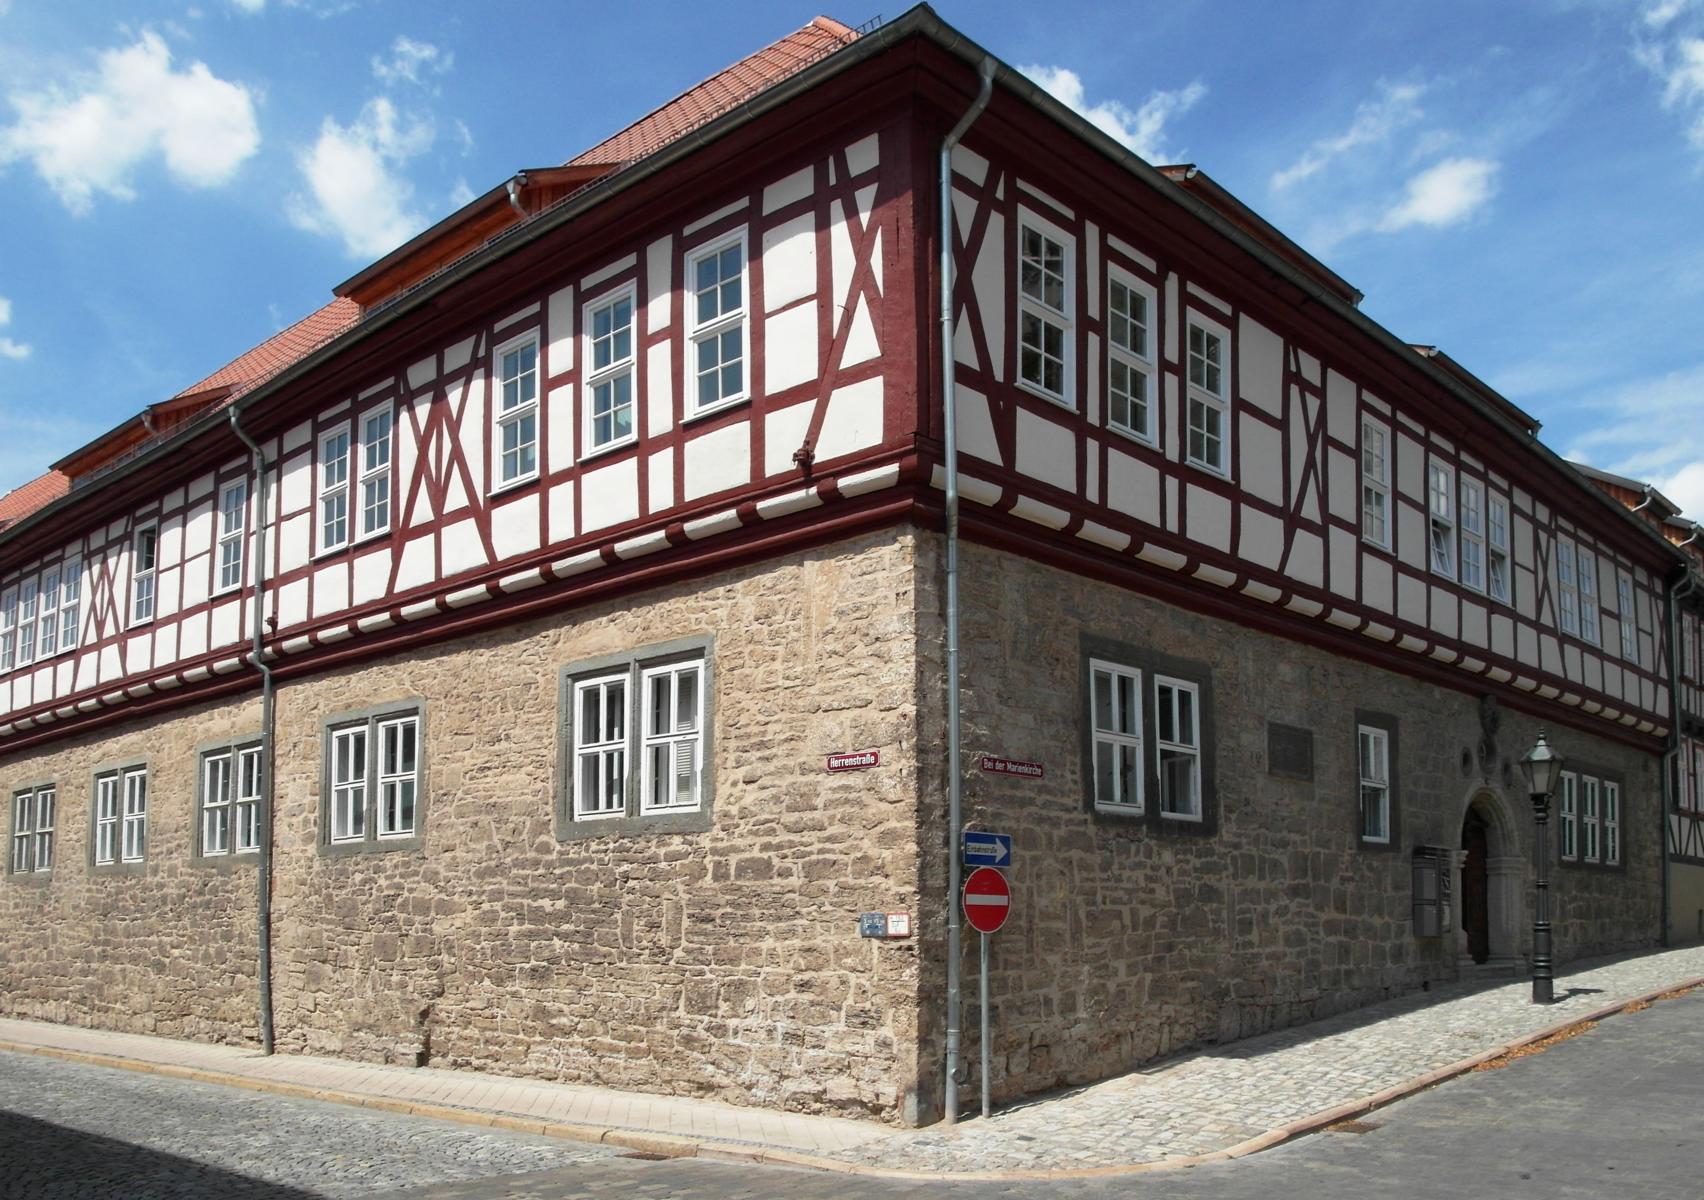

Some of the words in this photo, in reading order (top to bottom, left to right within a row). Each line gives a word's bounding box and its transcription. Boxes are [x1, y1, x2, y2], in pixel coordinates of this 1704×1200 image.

[830, 754, 875, 768] Herrenstraße
[983, 758, 994, 769] Bei
[995, 760, 1005, 770] der
[1006, 761, 1042, 776] Marienkirche
